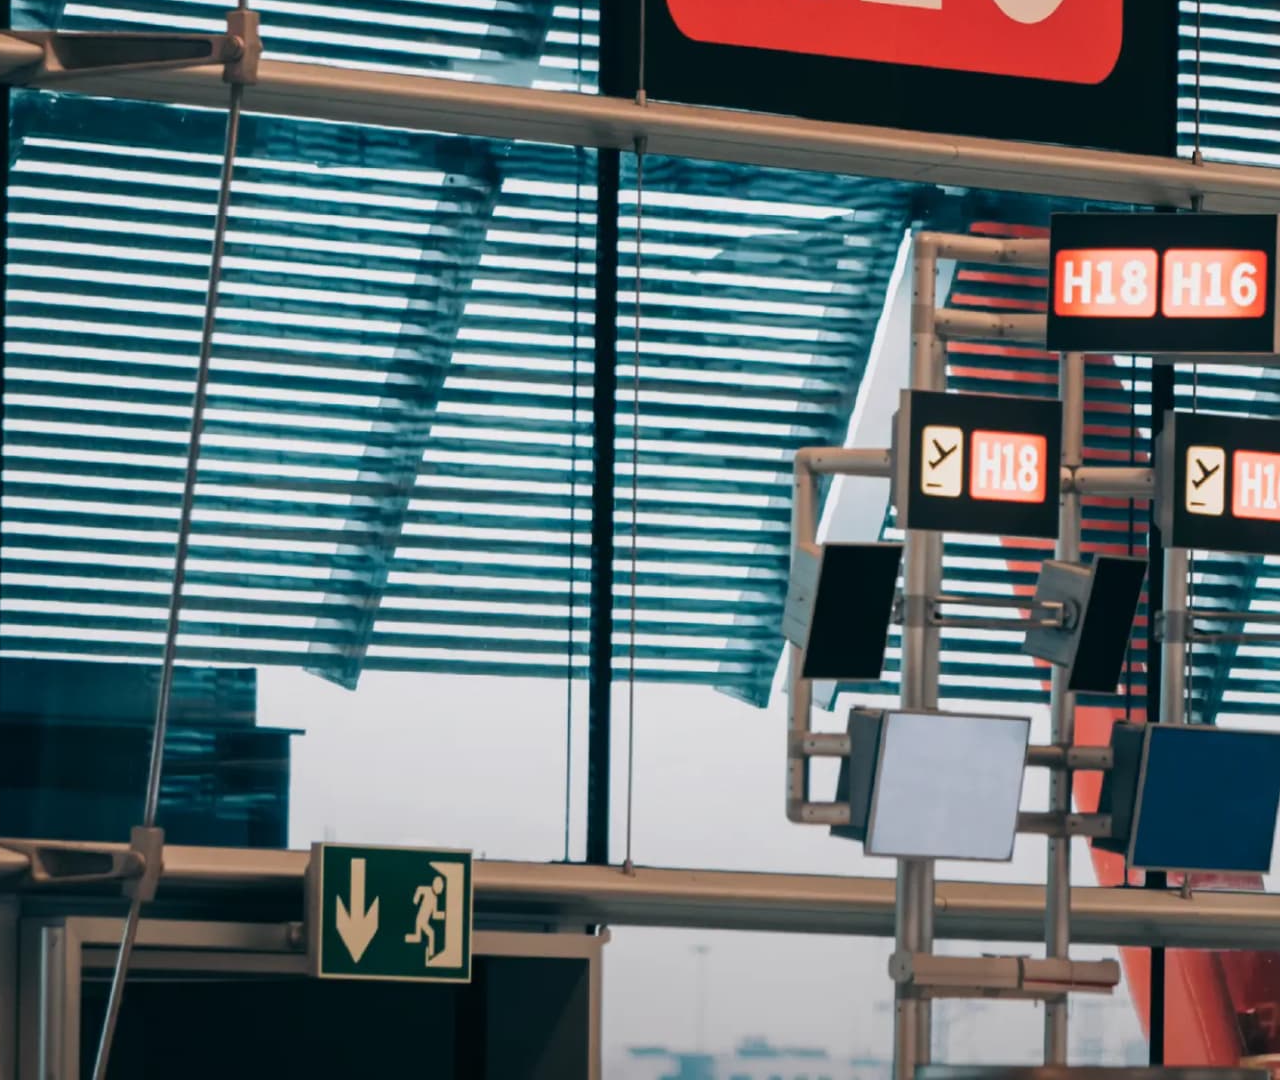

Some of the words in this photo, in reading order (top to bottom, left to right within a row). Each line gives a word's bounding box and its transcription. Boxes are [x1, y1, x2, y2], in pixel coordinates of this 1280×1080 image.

[1063, 260, 1148, 305] H18
[1172, 262, 1258, 307] H16
[978, 441, 1039, 493] H18
